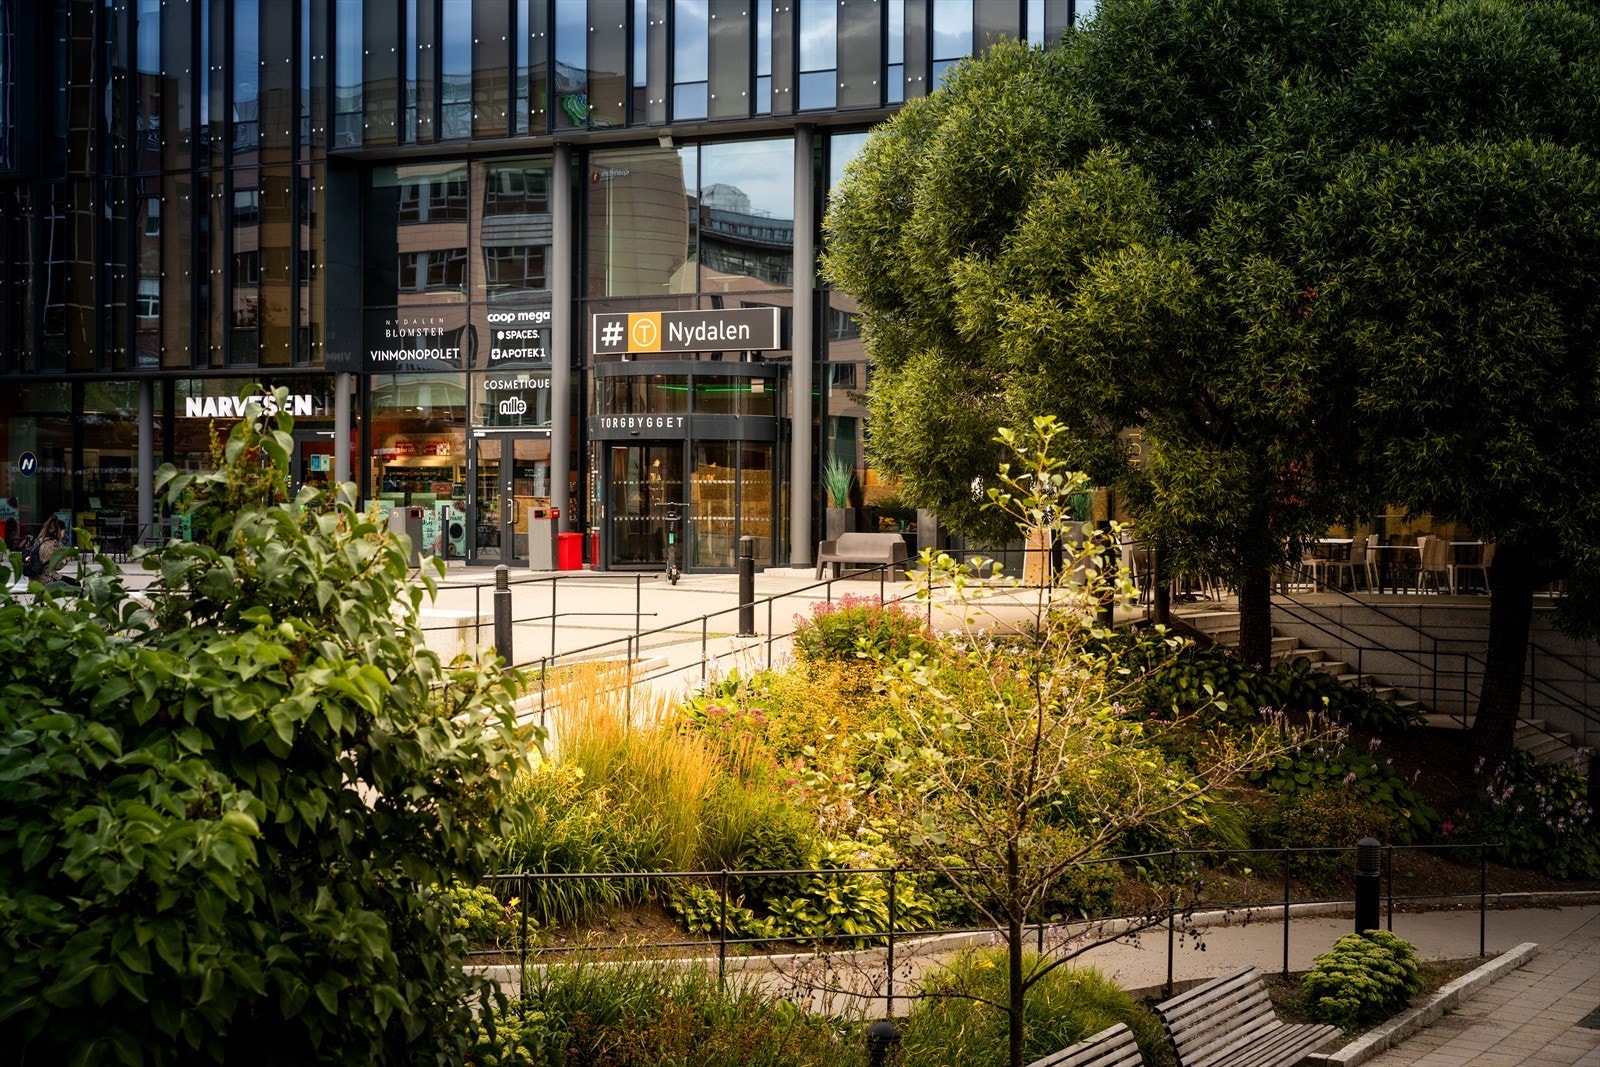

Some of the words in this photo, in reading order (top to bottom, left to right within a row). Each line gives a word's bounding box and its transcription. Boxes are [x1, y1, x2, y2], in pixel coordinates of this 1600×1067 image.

[385, 317, 444, 326] NYDALEN
[487, 312, 516, 323] coop
[517, 311, 551, 323] mega
[385, 327, 444, 338] BLOMSTER
[600, 321, 624, 347] #
[669, 319, 750, 346] Nydalen
[370, 348, 460, 361] VINMONOPOLET
[483, 378, 550, 390] COSMETIQUE
[499, 396, 527, 415] nille
[600, 417, 684, 429] TORGBYGGET
